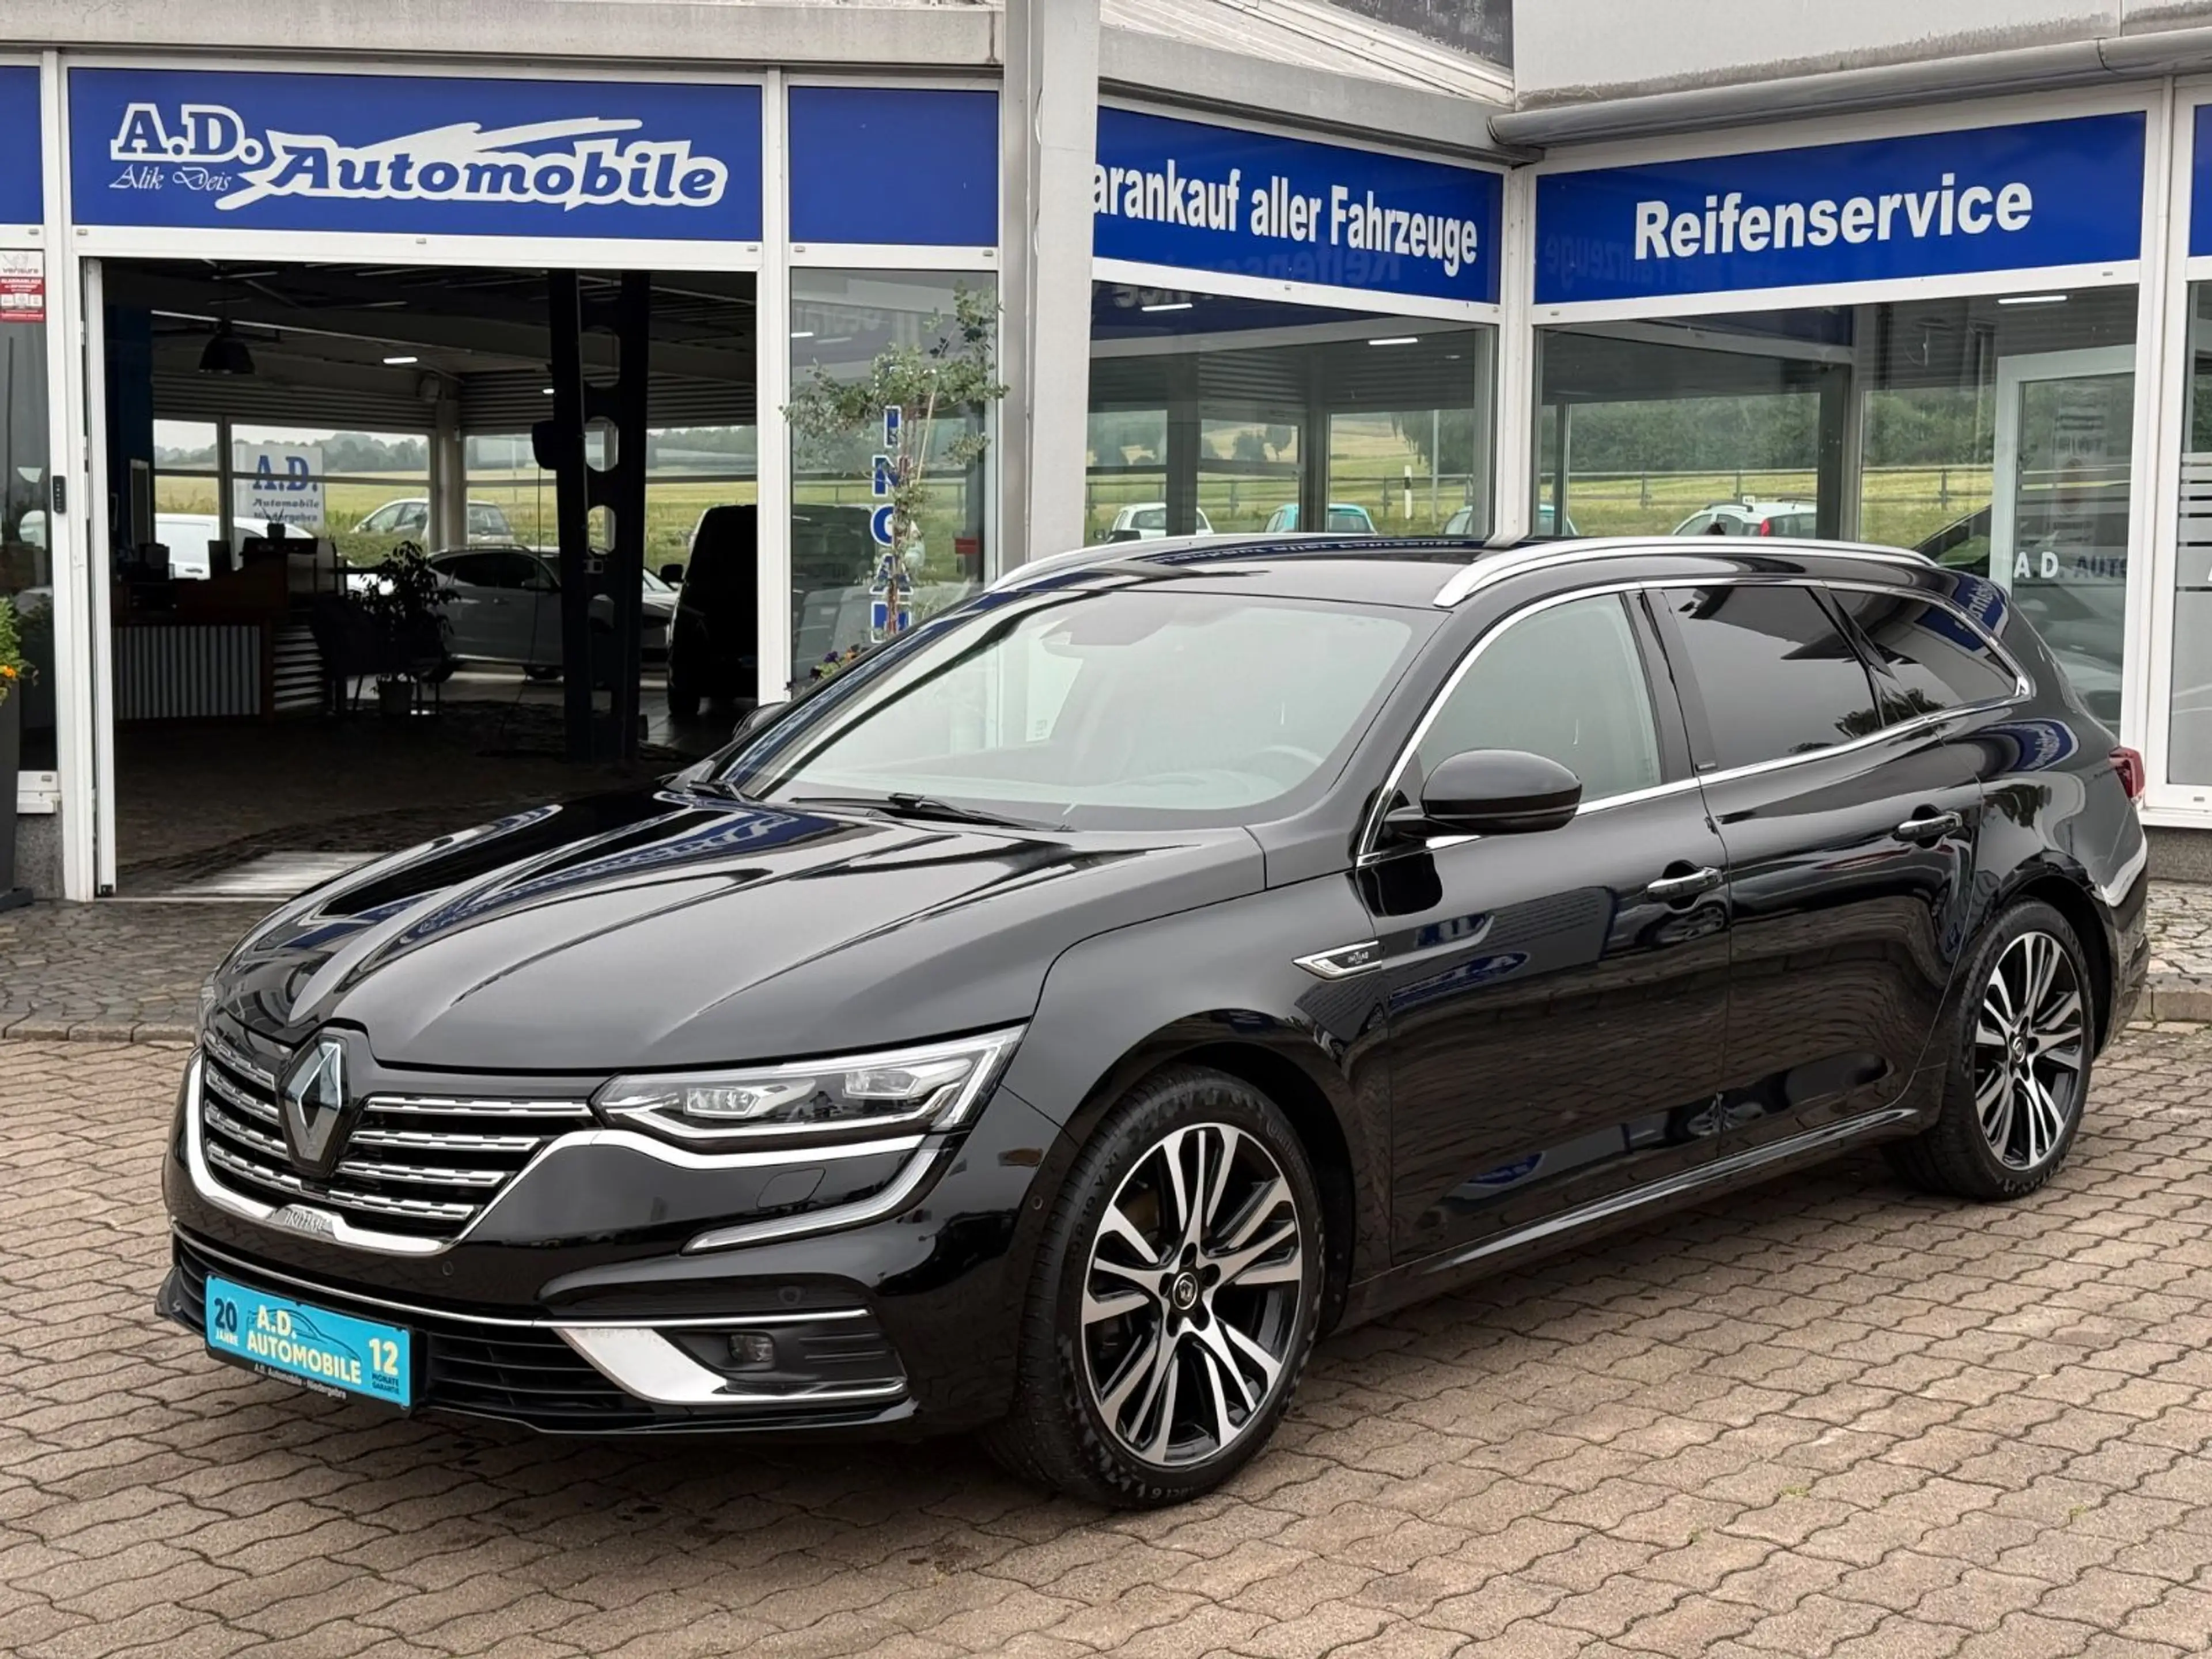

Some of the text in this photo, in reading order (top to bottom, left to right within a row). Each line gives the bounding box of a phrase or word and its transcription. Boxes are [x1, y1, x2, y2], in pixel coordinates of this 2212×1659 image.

[110, 103, 264, 164] A.D.
[108, 164, 232, 192] Alik Deis
[262, 142, 724, 207] Automobile
[1093, 159, 1478, 277] arankauf aller Fahrzeuge
[1634, 173, 2033, 260] Reifenservice
[252, 454, 318, 493] A.D.
[252, 498, 319, 507] Automobile
[214, 1298, 237, 1332] 20
[257, 1304, 297, 1339] A.D.
[247, 1330, 362, 1385] AUTOMOBILE
[369, 1338, 399, 1376] 12
